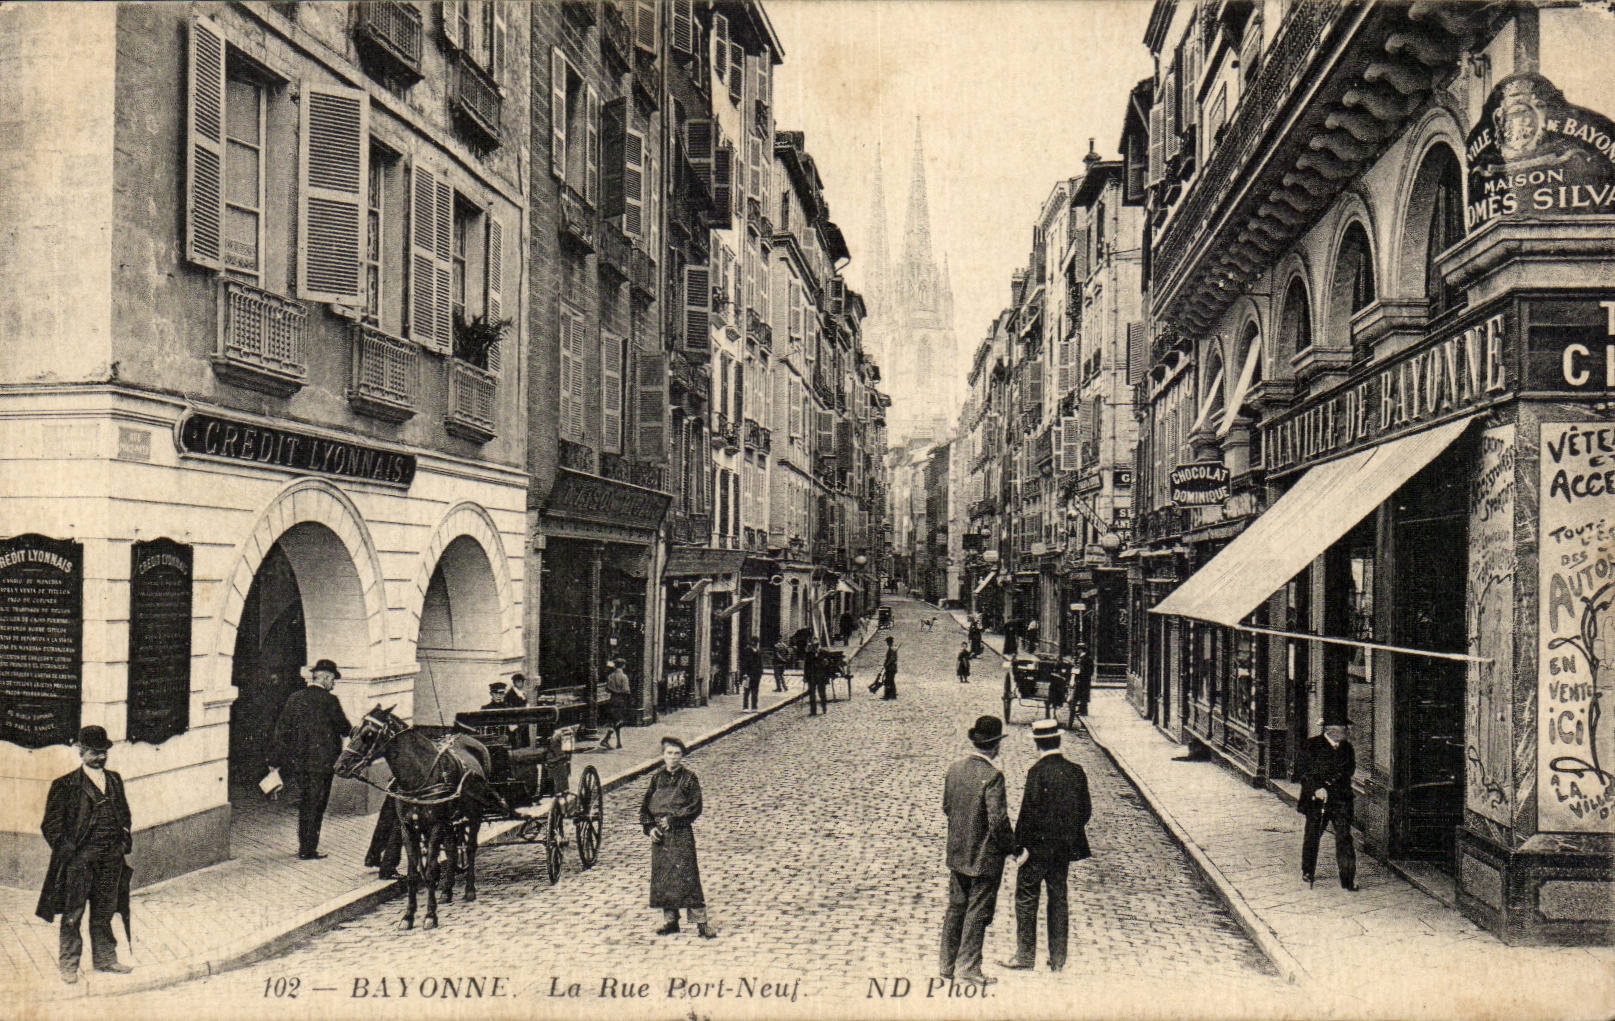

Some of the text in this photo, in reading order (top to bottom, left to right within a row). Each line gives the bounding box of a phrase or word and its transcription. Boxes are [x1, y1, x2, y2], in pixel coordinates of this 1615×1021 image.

[1466, 128, 1492, 162] VILLE
[1484, 168, 1563, 195] MAISON
[1346, 382, 1368, 444] DE
[1379, 314, 1505, 430] BAYONNE
[1563, 344, 1615, 387] C
[1547, 425, 1615, 464] VÊTE
[307, 439, 403, 482] LYONNAIS
[1171, 466, 1229, 485] CHOCOLAT
[1172, 486, 1230, 504] DOMINIQUE
[28, 549, 73, 573] LYONNAIS
[1549, 654, 1577, 676] EN
[1548, 680, 1593, 704] VENTE
